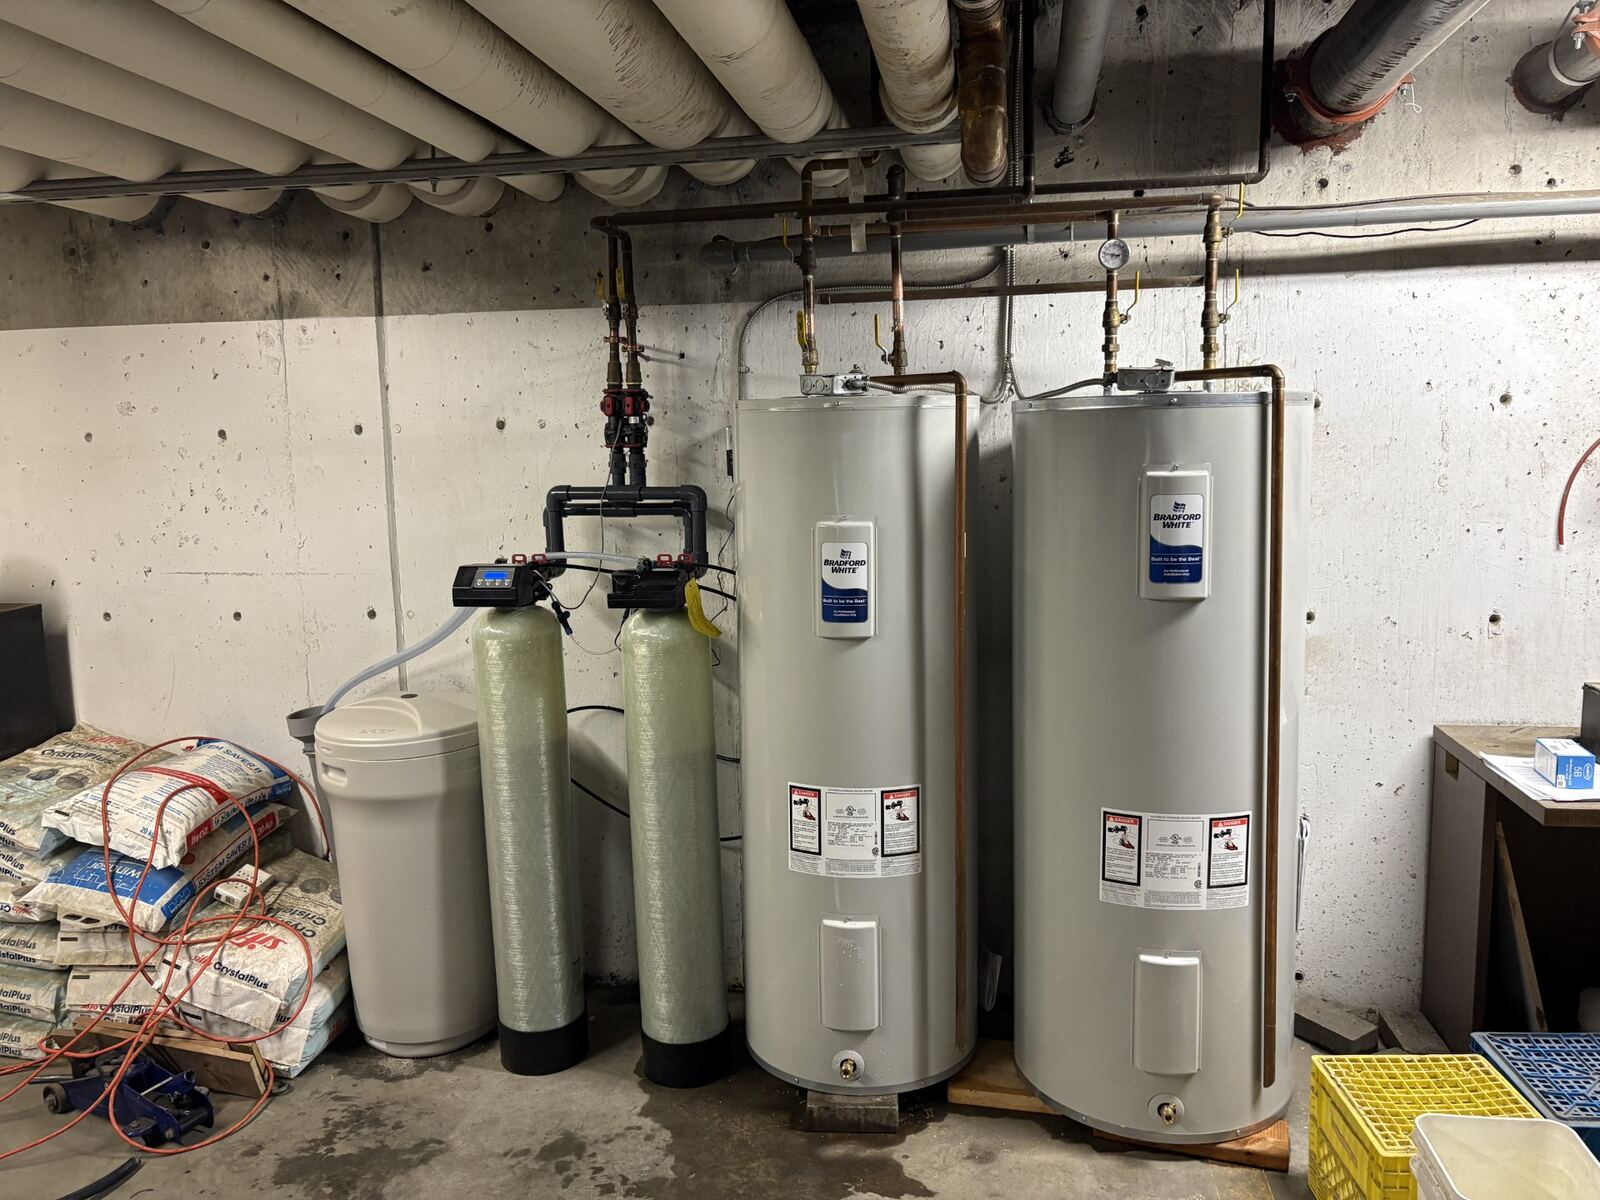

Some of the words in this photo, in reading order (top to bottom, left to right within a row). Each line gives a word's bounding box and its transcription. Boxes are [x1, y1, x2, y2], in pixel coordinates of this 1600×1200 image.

[1153, 513, 1201, 521] BRADFORD
[1162, 521, 1192, 529] WHITE
[823, 559, 866, 567] BRADFORD
[223, 749, 255, 771] SAVER
[197, 858, 225, 886] SYSTEM
[226, 841, 246, 863] SAVER
[213, 961, 269, 990] CrystalPlus
